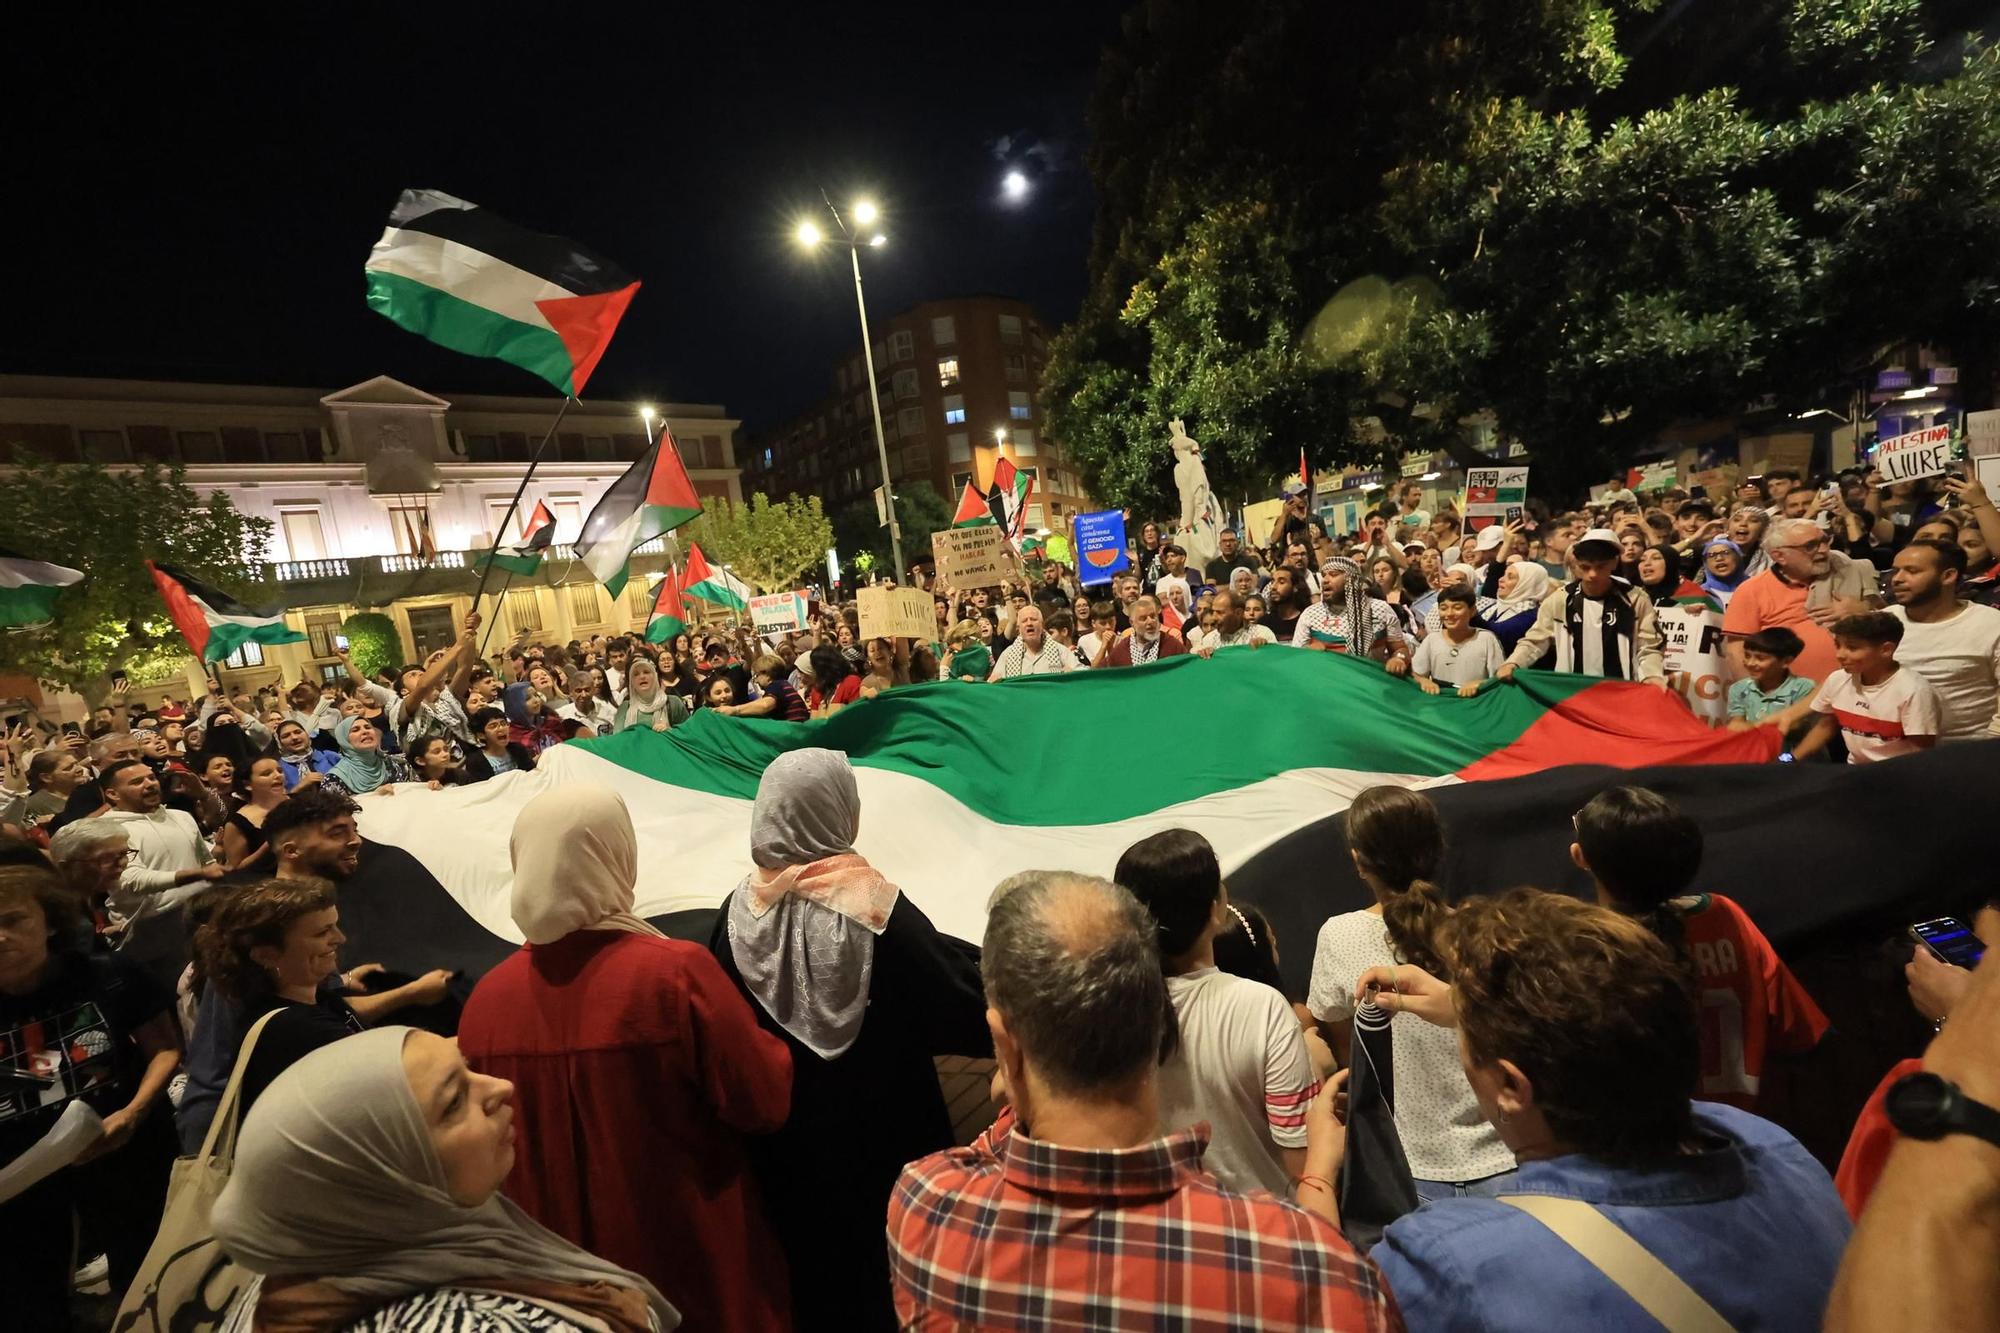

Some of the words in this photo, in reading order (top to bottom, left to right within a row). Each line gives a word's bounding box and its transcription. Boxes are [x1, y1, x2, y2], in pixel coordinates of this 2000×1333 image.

[1880, 426, 1949, 456] PALESTINA
[1877, 444, 1946, 484] LLIURE
[949, 532, 960, 541] YA
[961, 530, 972, 539] QUE
[952, 543, 962, 553] YA
[989, 563, 996, 572] A
[1677, 622, 1685, 632] A
[1673, 634, 1689, 644] JA!
[1696, 938, 1738, 977] RA
